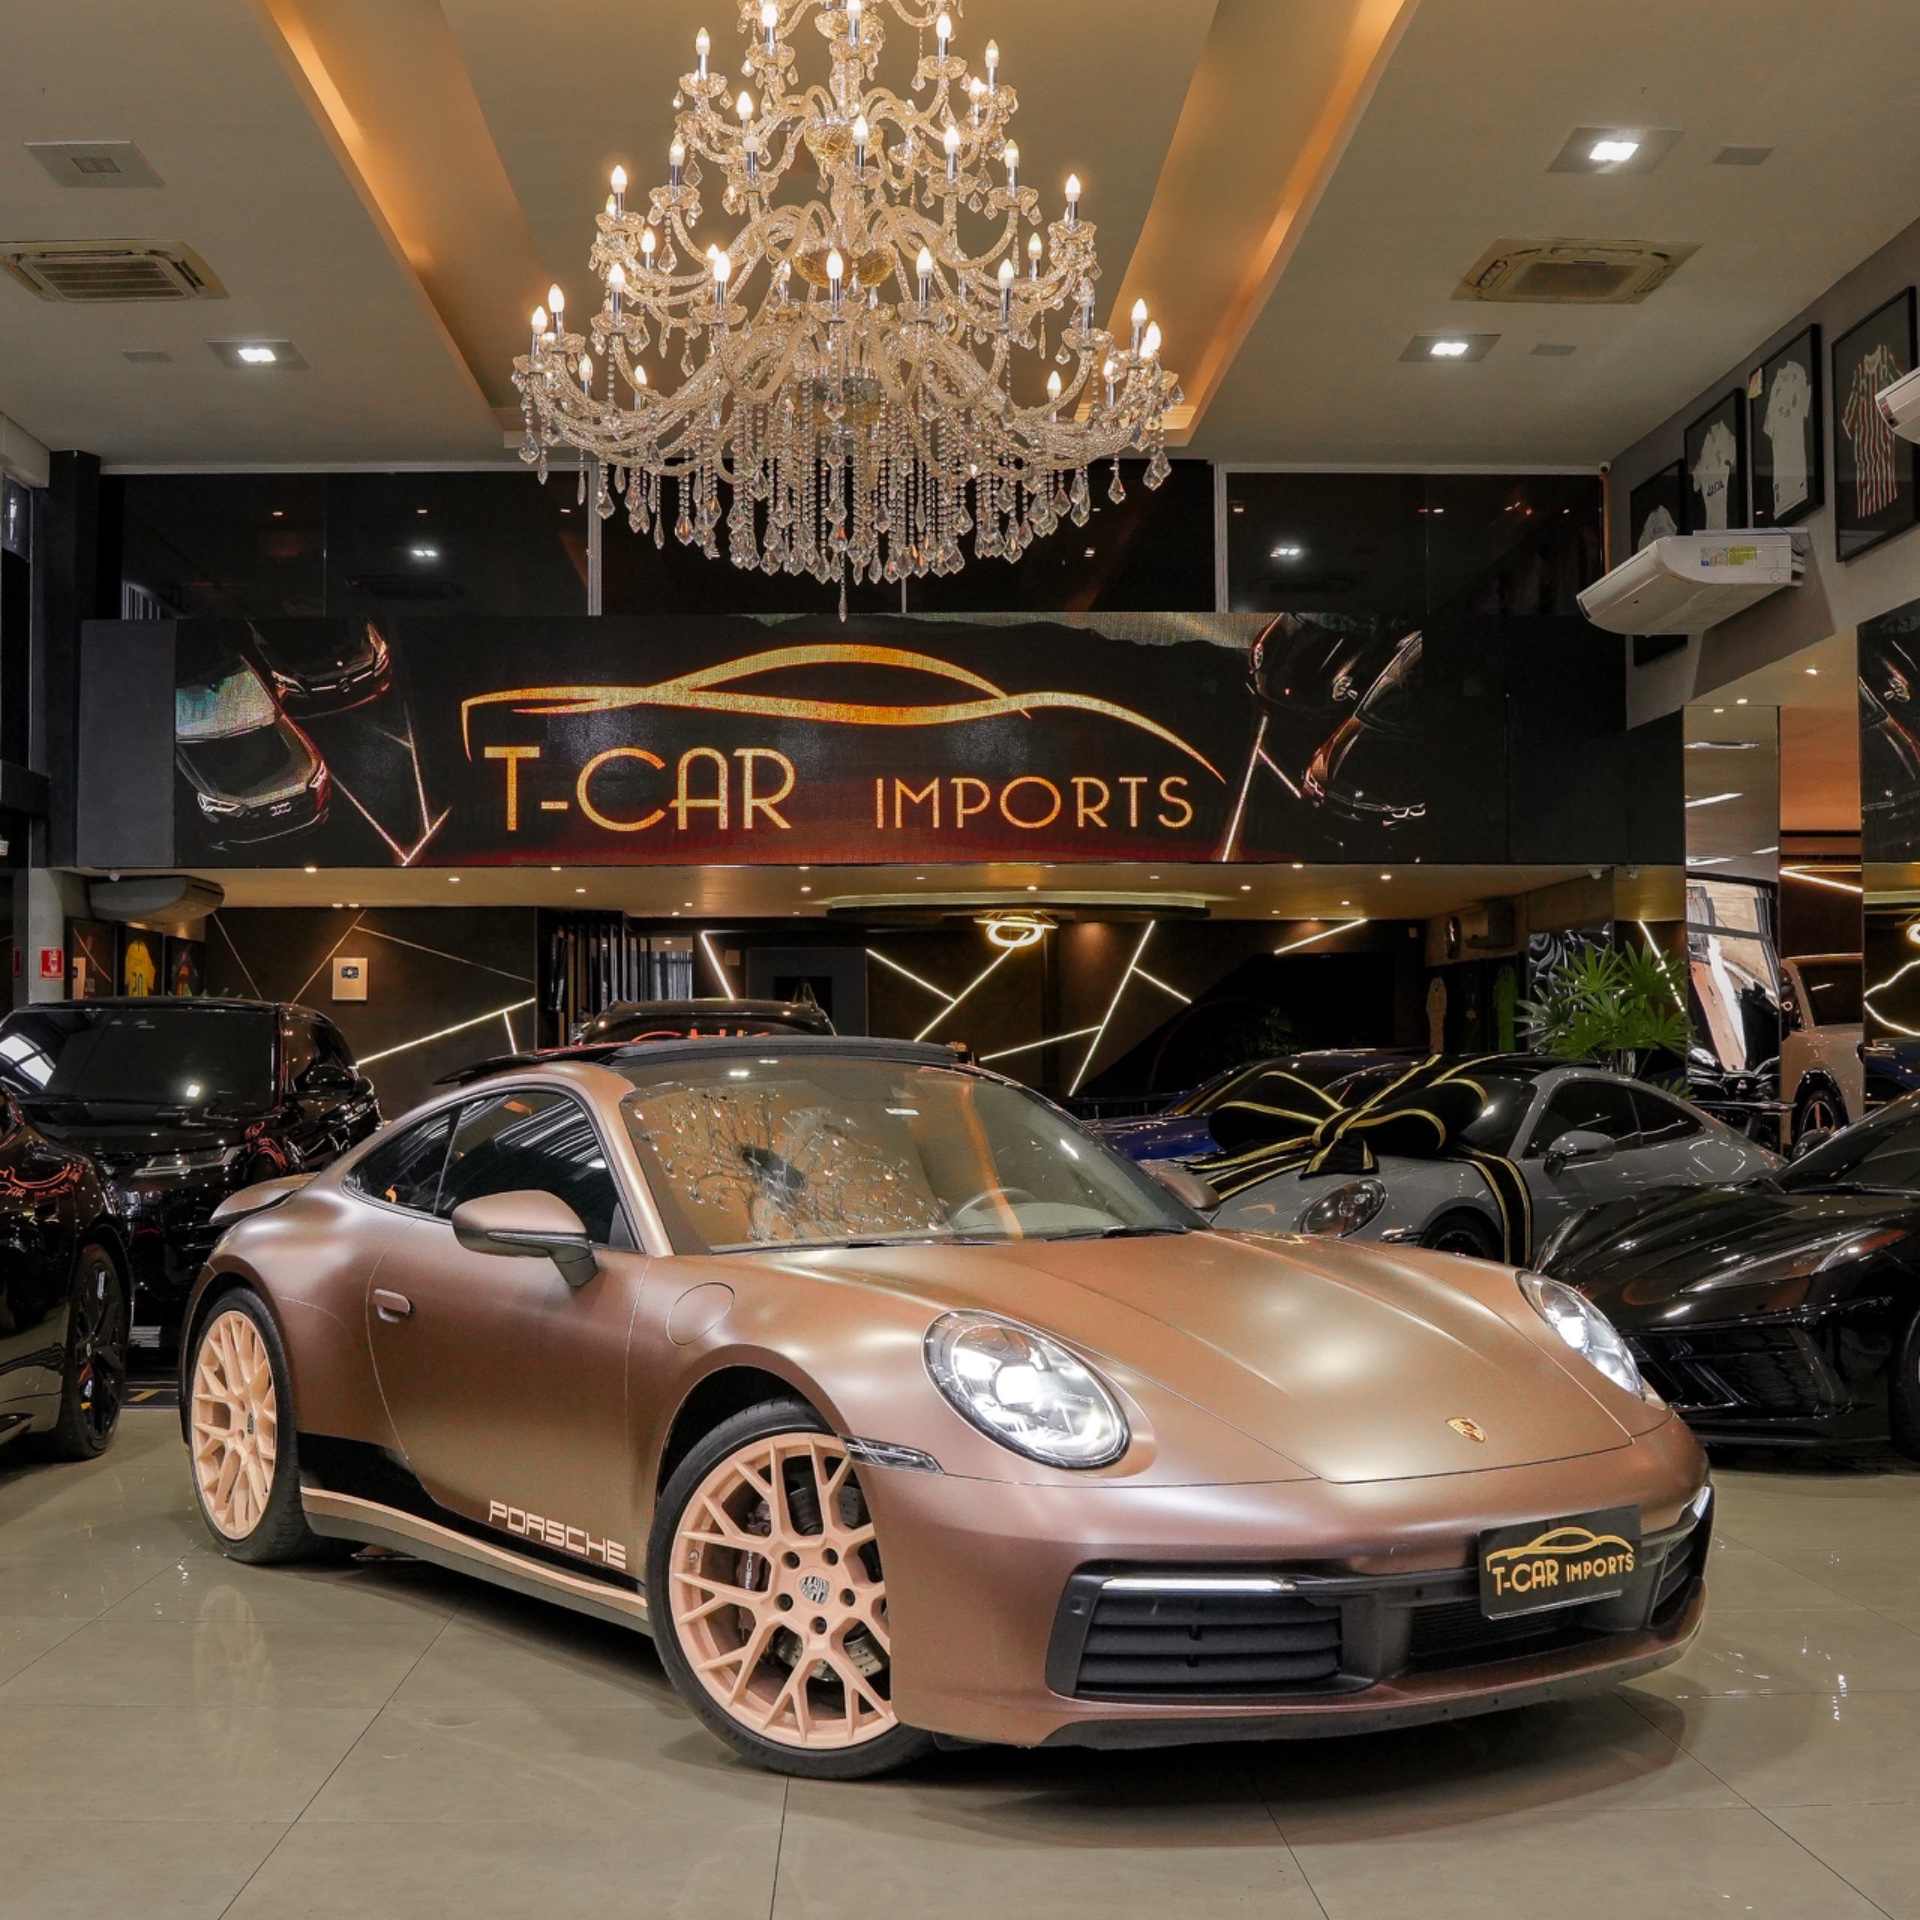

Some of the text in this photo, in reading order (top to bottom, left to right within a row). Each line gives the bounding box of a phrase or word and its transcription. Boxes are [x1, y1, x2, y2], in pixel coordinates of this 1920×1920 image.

[484, 746, 1193, 832] T-CAR IMPORTS
[489, 1500, 627, 1570] PORSCHE
[1492, 1553, 1635, 1595] T-CAR IMPORTS
